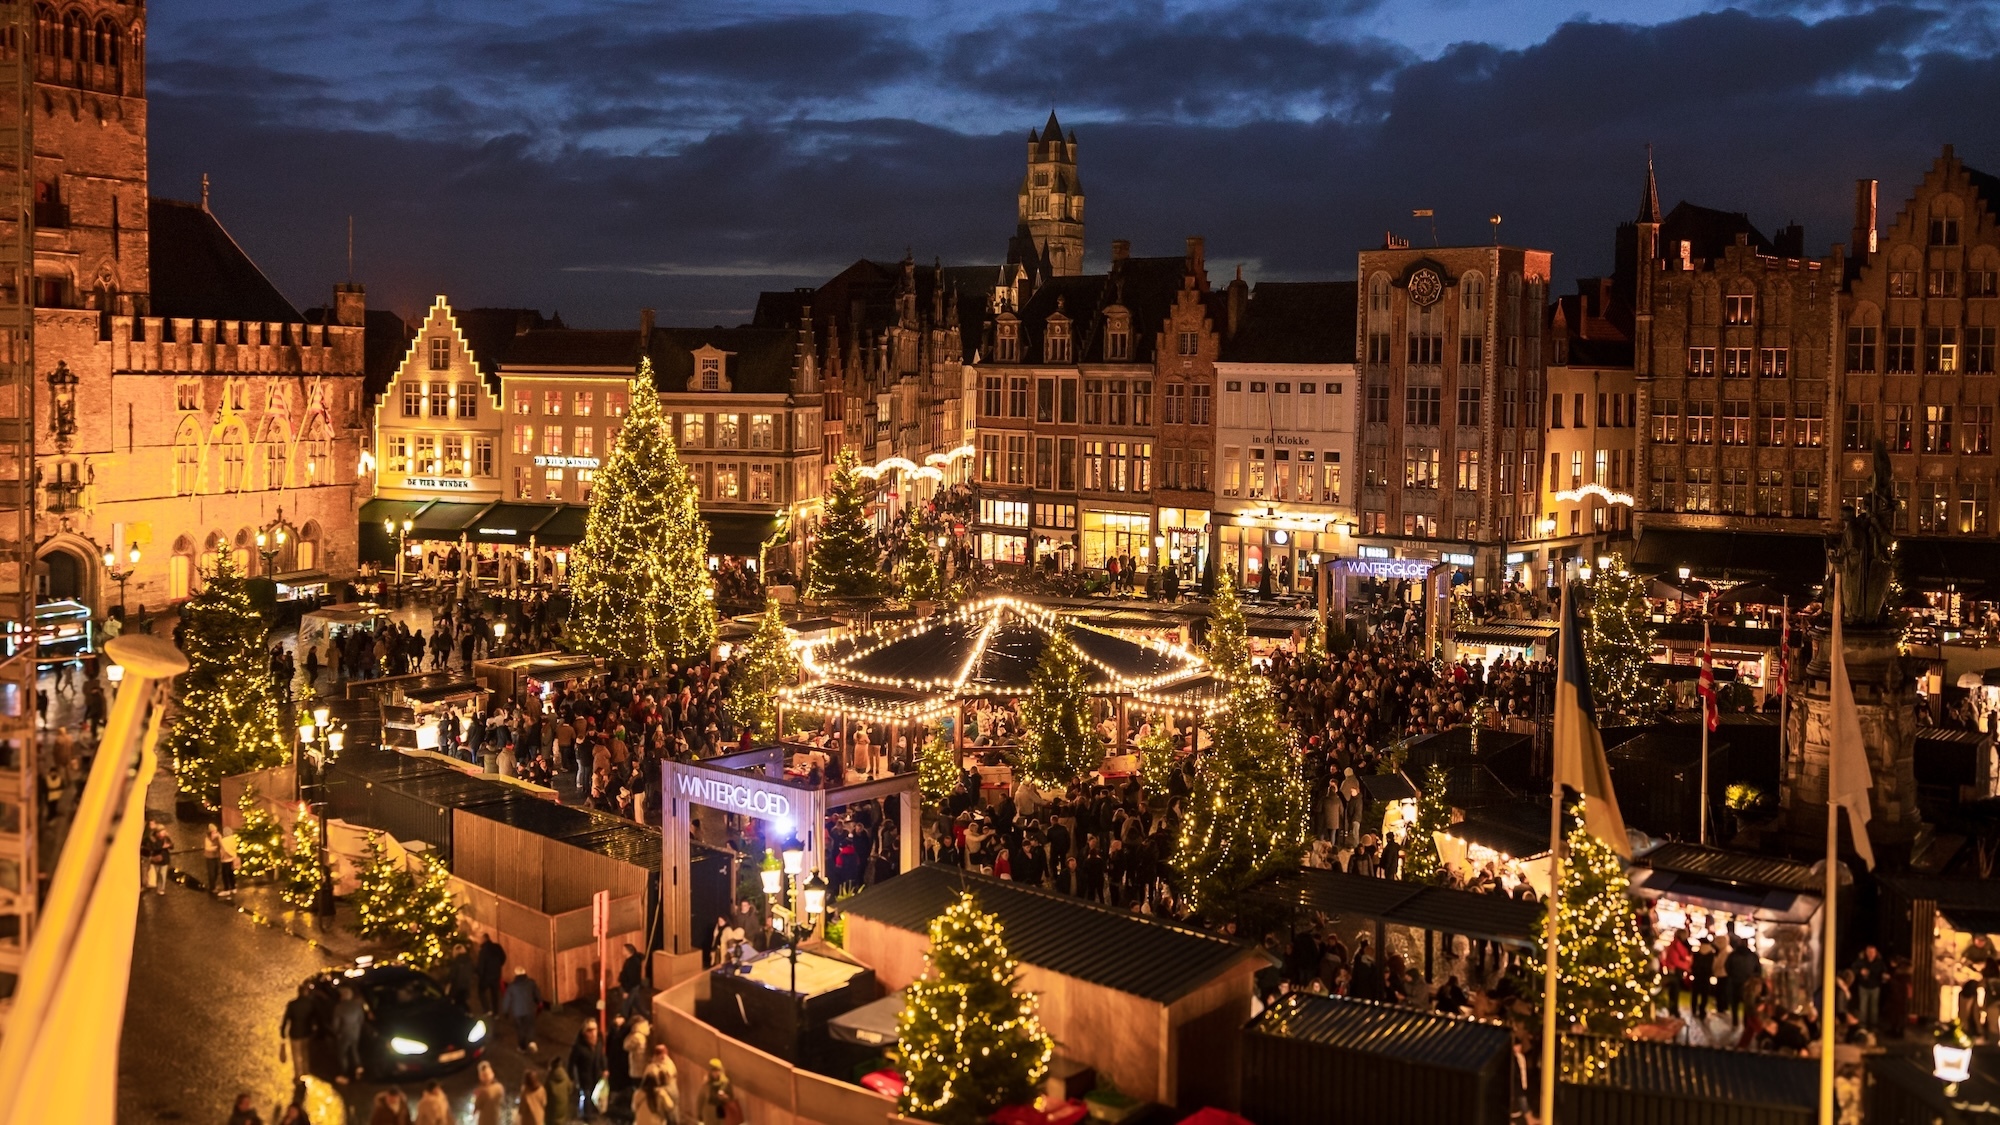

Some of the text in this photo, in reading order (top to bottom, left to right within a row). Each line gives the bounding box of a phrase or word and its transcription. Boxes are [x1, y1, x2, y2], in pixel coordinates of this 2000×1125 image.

[1252, 434, 1261, 444] in
[1276, 435, 1310, 446] Klokke
[407, 478, 468, 488] DE VIER WINDEN
[677, 772, 790, 818] WINTERGLOED
